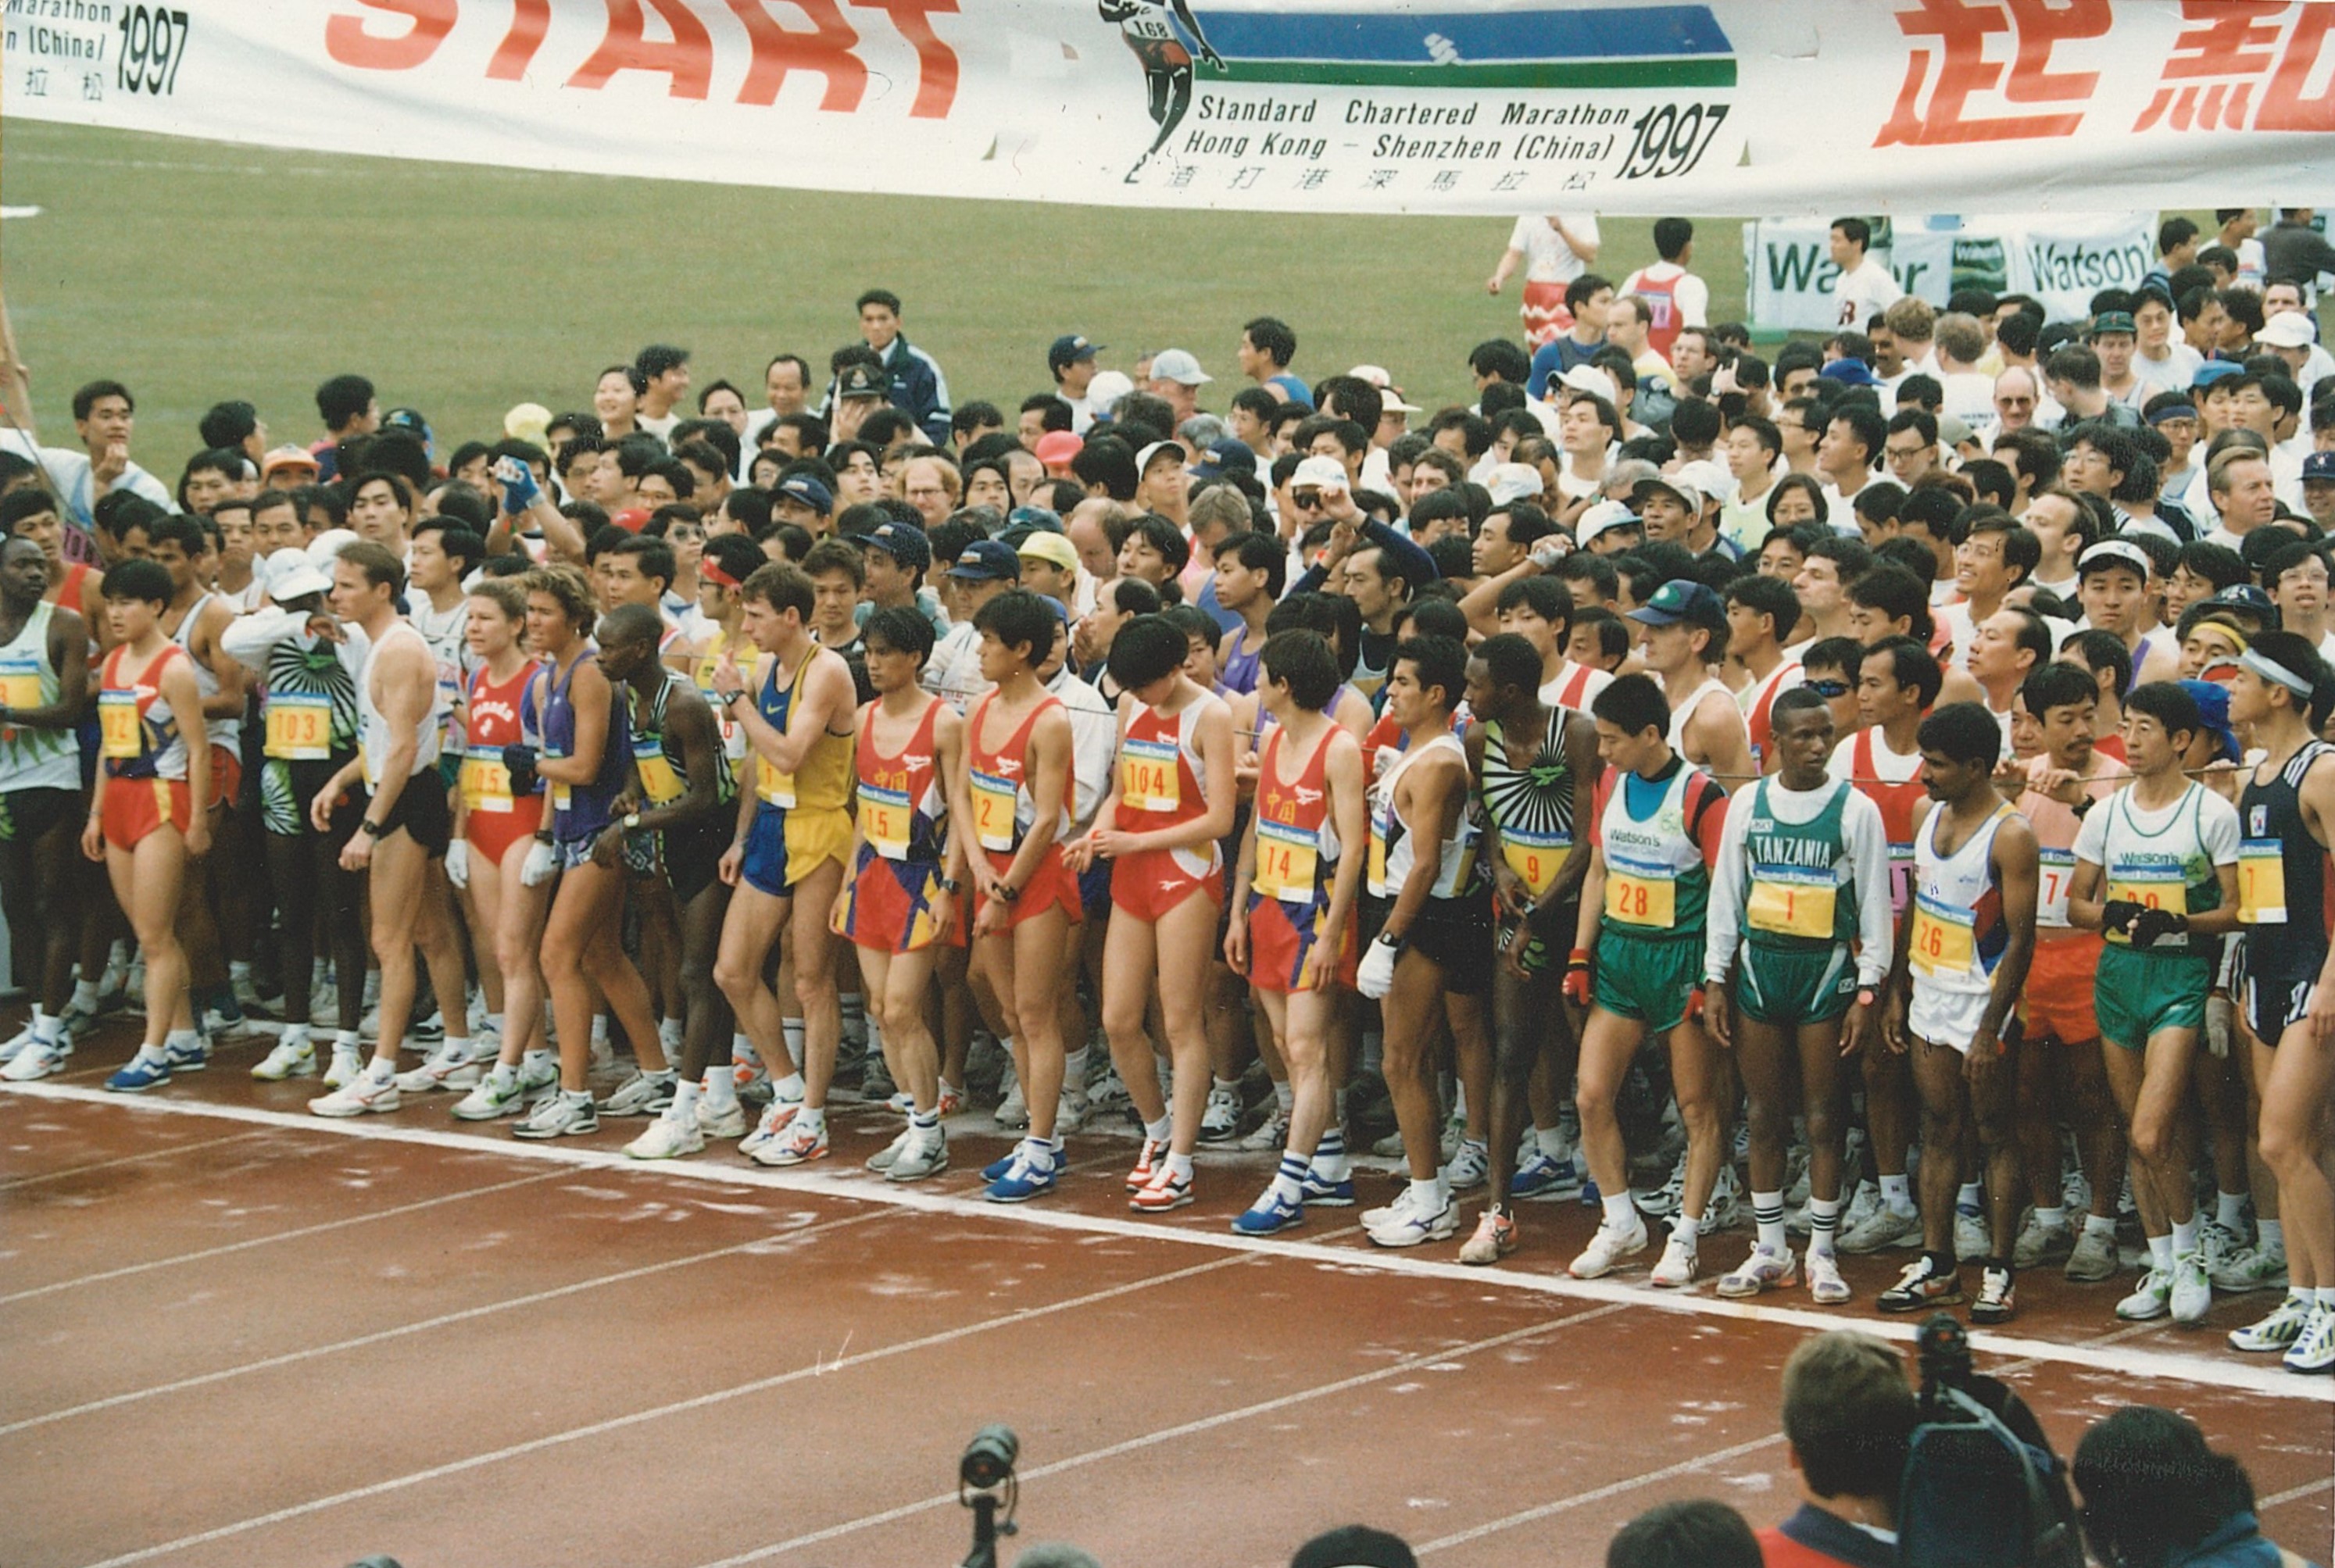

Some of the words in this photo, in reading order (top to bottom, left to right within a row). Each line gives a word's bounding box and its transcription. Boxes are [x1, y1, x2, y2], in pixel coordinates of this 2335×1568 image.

[119, 5, 188, 95] 1997
[1199, 95, 1318, 123] Standard
[1345, 99, 1478, 126] Chartered
[1501, 102, 1630, 125] Marathon
[1183, 130, 1250, 158] Hong
[1260, 132, 1328, 160] Kong
[1372, 134, 1501, 159] Shenzhen
[1614, 102, 1730, 180] 1997
[277, 713, 315, 741] 103
[1129, 763, 1164, 796] 104
[867, 808, 888, 838] 15
[1268, 846, 1290, 880] 14
[1754, 836, 1831, 869] TANZANIA
[1527, 856, 1539, 884] 9
[1619, 884, 1648, 916] 28
[1786, 890, 1793, 922] 1
[1919, 920, 1943, 958] 26
